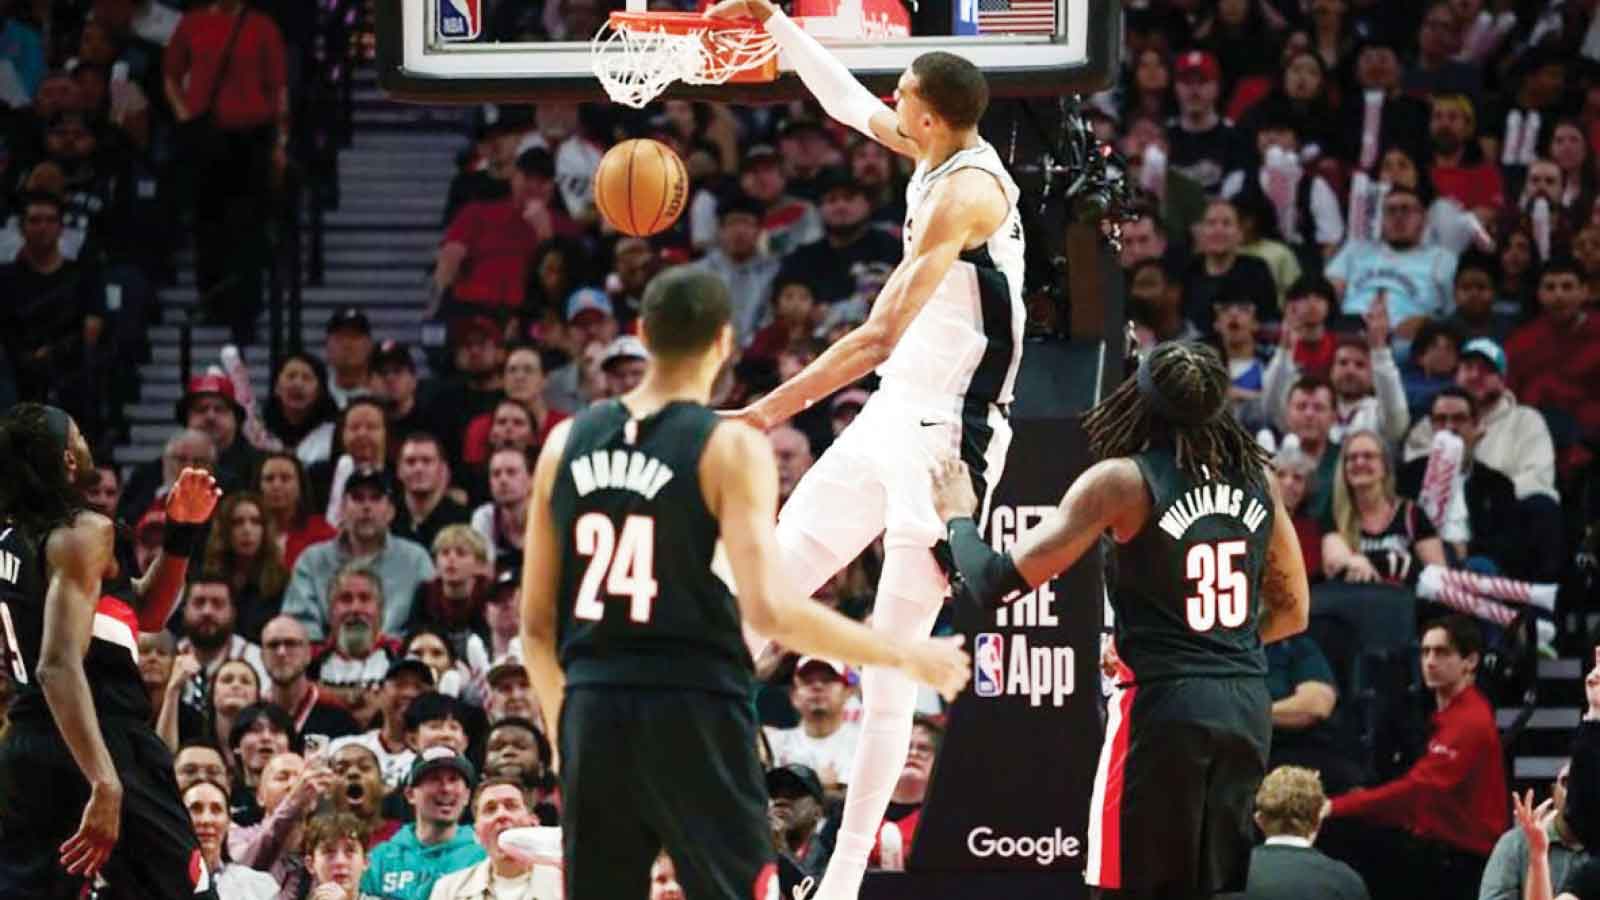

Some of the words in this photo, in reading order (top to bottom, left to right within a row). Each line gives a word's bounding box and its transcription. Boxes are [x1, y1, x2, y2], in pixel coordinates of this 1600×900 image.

[570, 450, 675, 500] MURRAY
[1158, 483, 1244, 540] WILLIAMS
[573, 511, 660, 624] 24
[1185, 540, 1249, 633] 35
[1006, 633, 1075, 708] App
[966, 825, 1081, 866] Google
